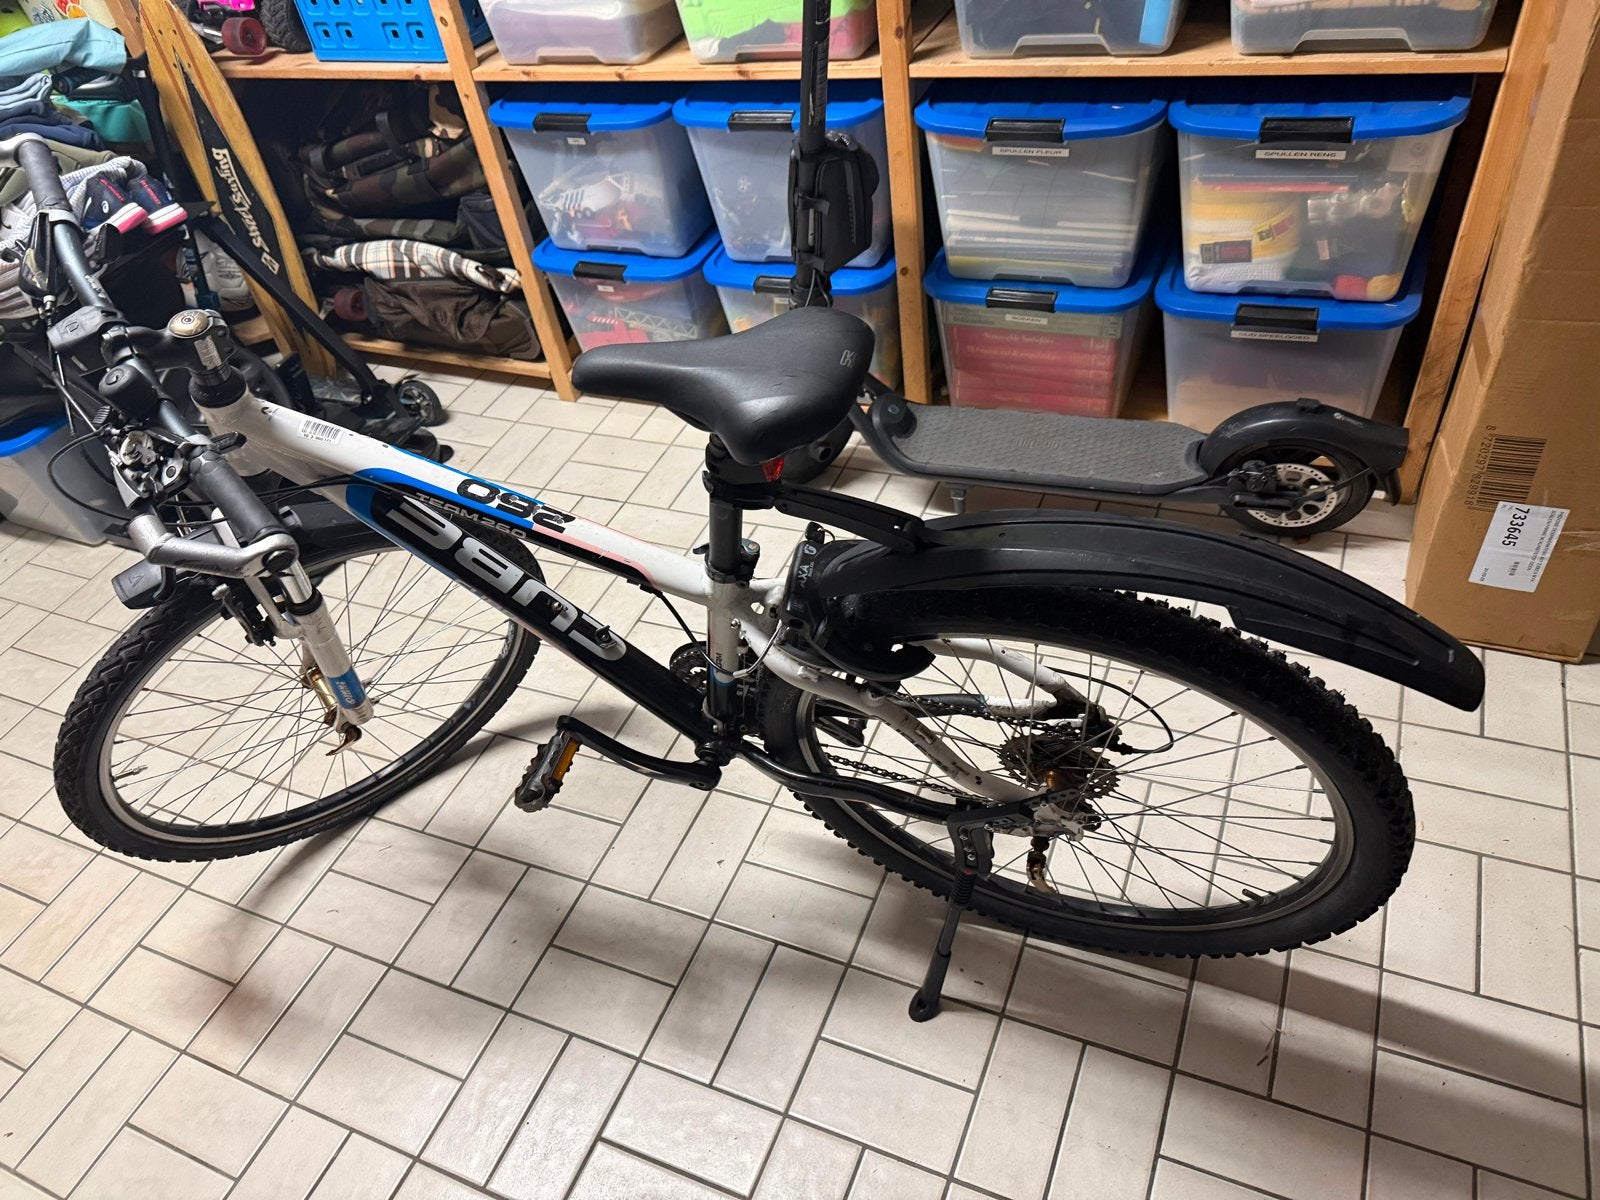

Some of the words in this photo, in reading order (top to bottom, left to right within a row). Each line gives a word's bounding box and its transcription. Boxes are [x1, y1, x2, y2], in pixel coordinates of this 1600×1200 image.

[211, 147, 252, 211] Surfing
[233, 205, 270, 253] Street
[1475, 437, 1494, 471] 720297
[456, 478, 577, 534] 260
[1463, 472, 1482, 506] 829918
[416, 492, 481, 521] TEAM
[480, 515, 528, 540] 260
[1501, 507, 1531, 548] 733645
[386, 495, 627, 662] CUBE
[798, 565, 809, 589] AXA
